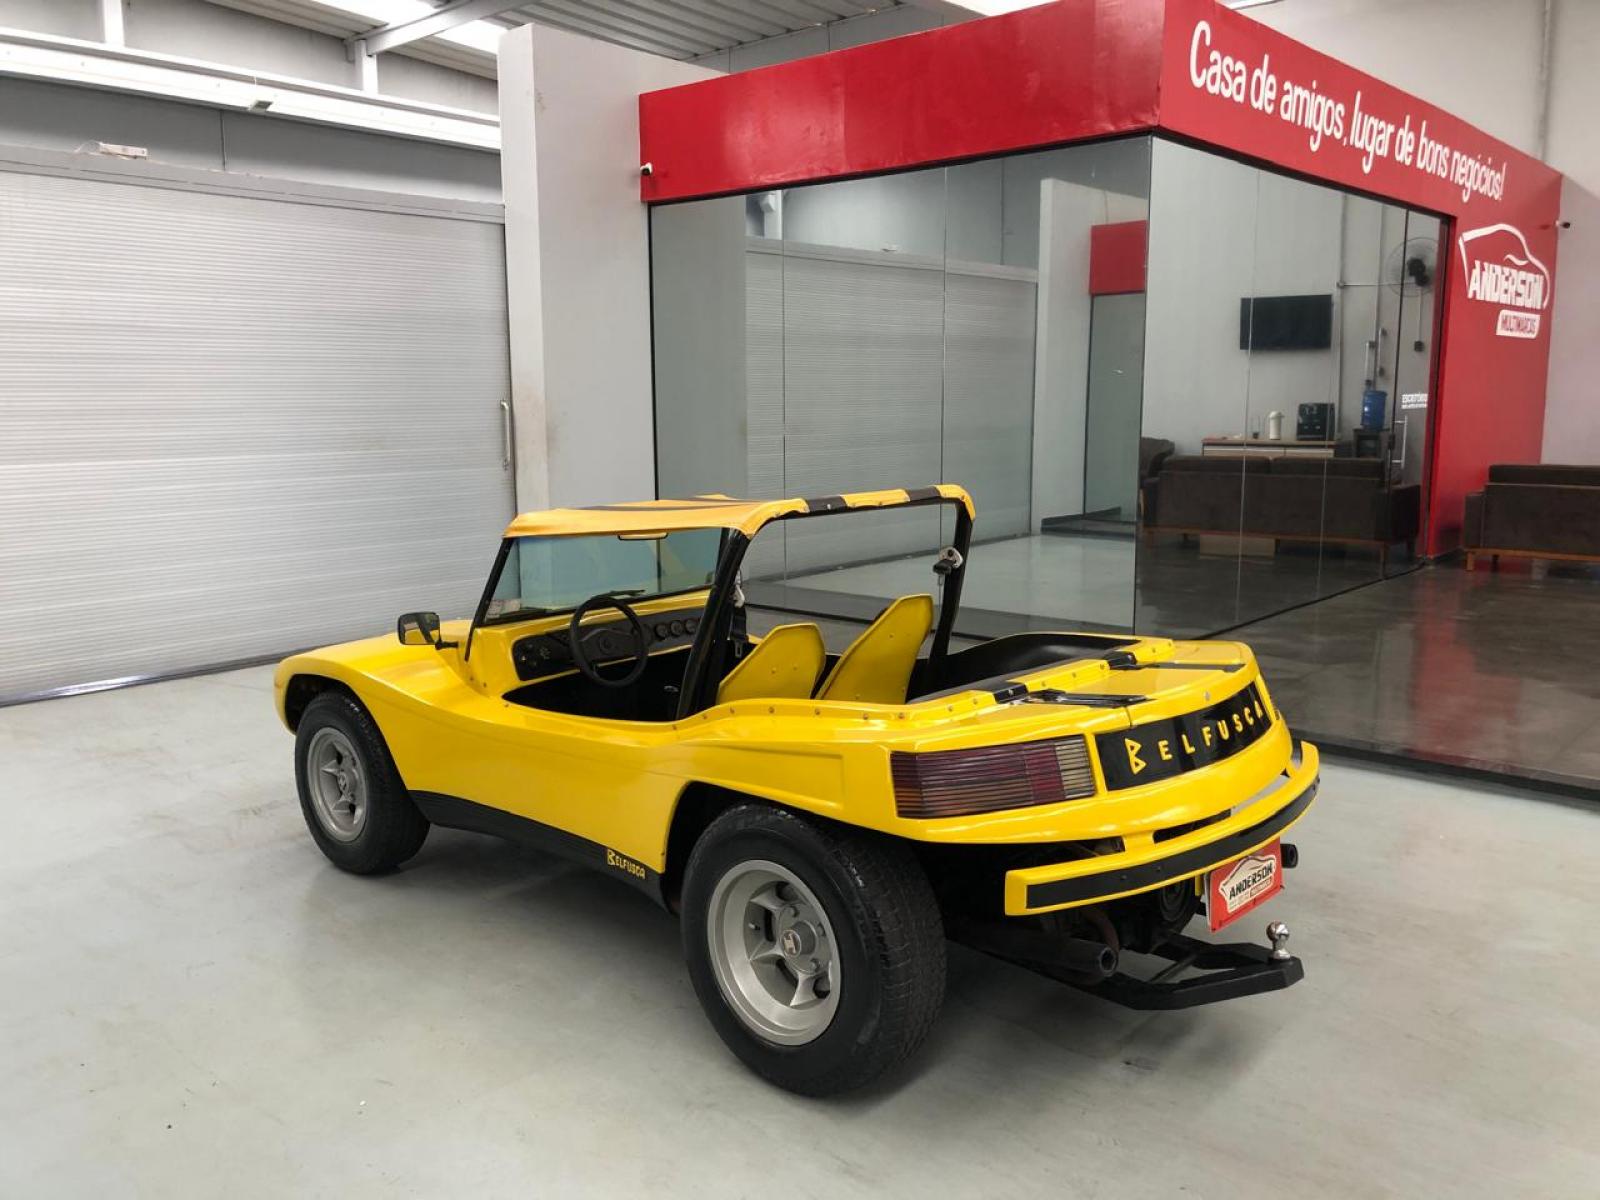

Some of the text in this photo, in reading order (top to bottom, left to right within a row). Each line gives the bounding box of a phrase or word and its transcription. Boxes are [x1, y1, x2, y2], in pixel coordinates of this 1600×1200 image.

[1189, 20, 1507, 203] Casa de amigos, lugar de bons negócios!
[1467, 259, 1544, 310] ANDERSON
[1124, 700, 1264, 775] BELFUSCA
[1229, 861, 1273, 900] ANDERSON
